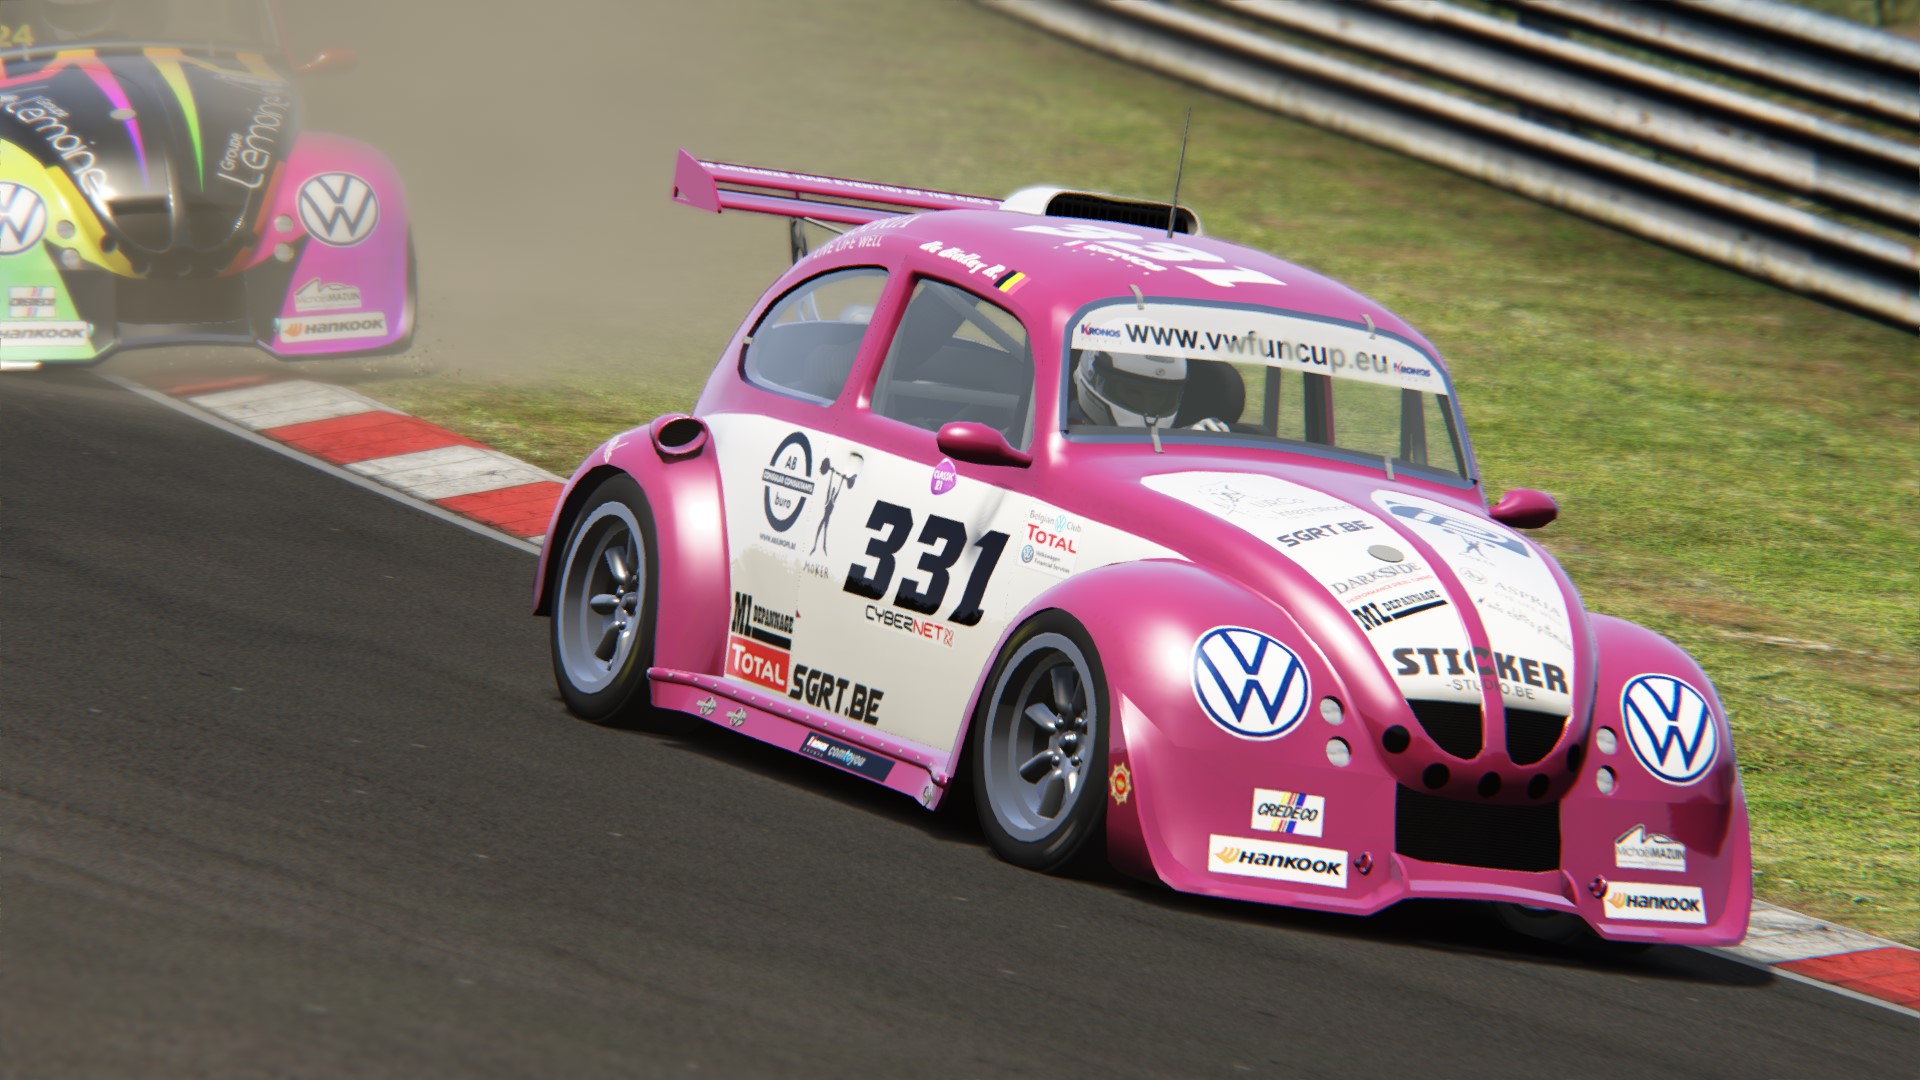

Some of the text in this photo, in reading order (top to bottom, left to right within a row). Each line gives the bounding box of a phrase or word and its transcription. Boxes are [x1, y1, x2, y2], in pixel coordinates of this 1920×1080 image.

[858, 235, 883, 248] WELL
[1011, 224, 1289, 288] 331
[1080, 322, 1121, 339] KRONOS
[1125, 322, 1389, 374] www.vwfuncup.eu
[1393, 361, 1432, 378] KRONOS
[785, 455, 798, 471] AB
[774, 492, 792, 509] buro
[1029, 509, 1055, 525] Belgian
[1066, 521, 1082, 533] Club
[1277, 520, 1375, 548] SGRT.BE
[1028, 523, 1077, 554] TOTAL
[803, 561, 830, 579] MOKER
[843, 500, 1011, 627] 331
[1330, 562, 1421, 595] DARKSIDE
[731, 591, 795, 638] ML DEPANNAGE
[1351, 589, 1441, 632] ML DEPANNAGE
[732, 642, 786, 687] TOTAL
[1391, 646, 1570, 695] STICKER
[788, 663, 885, 726] SGRT.BE
[1257, 802, 1319, 822] CREDECO
